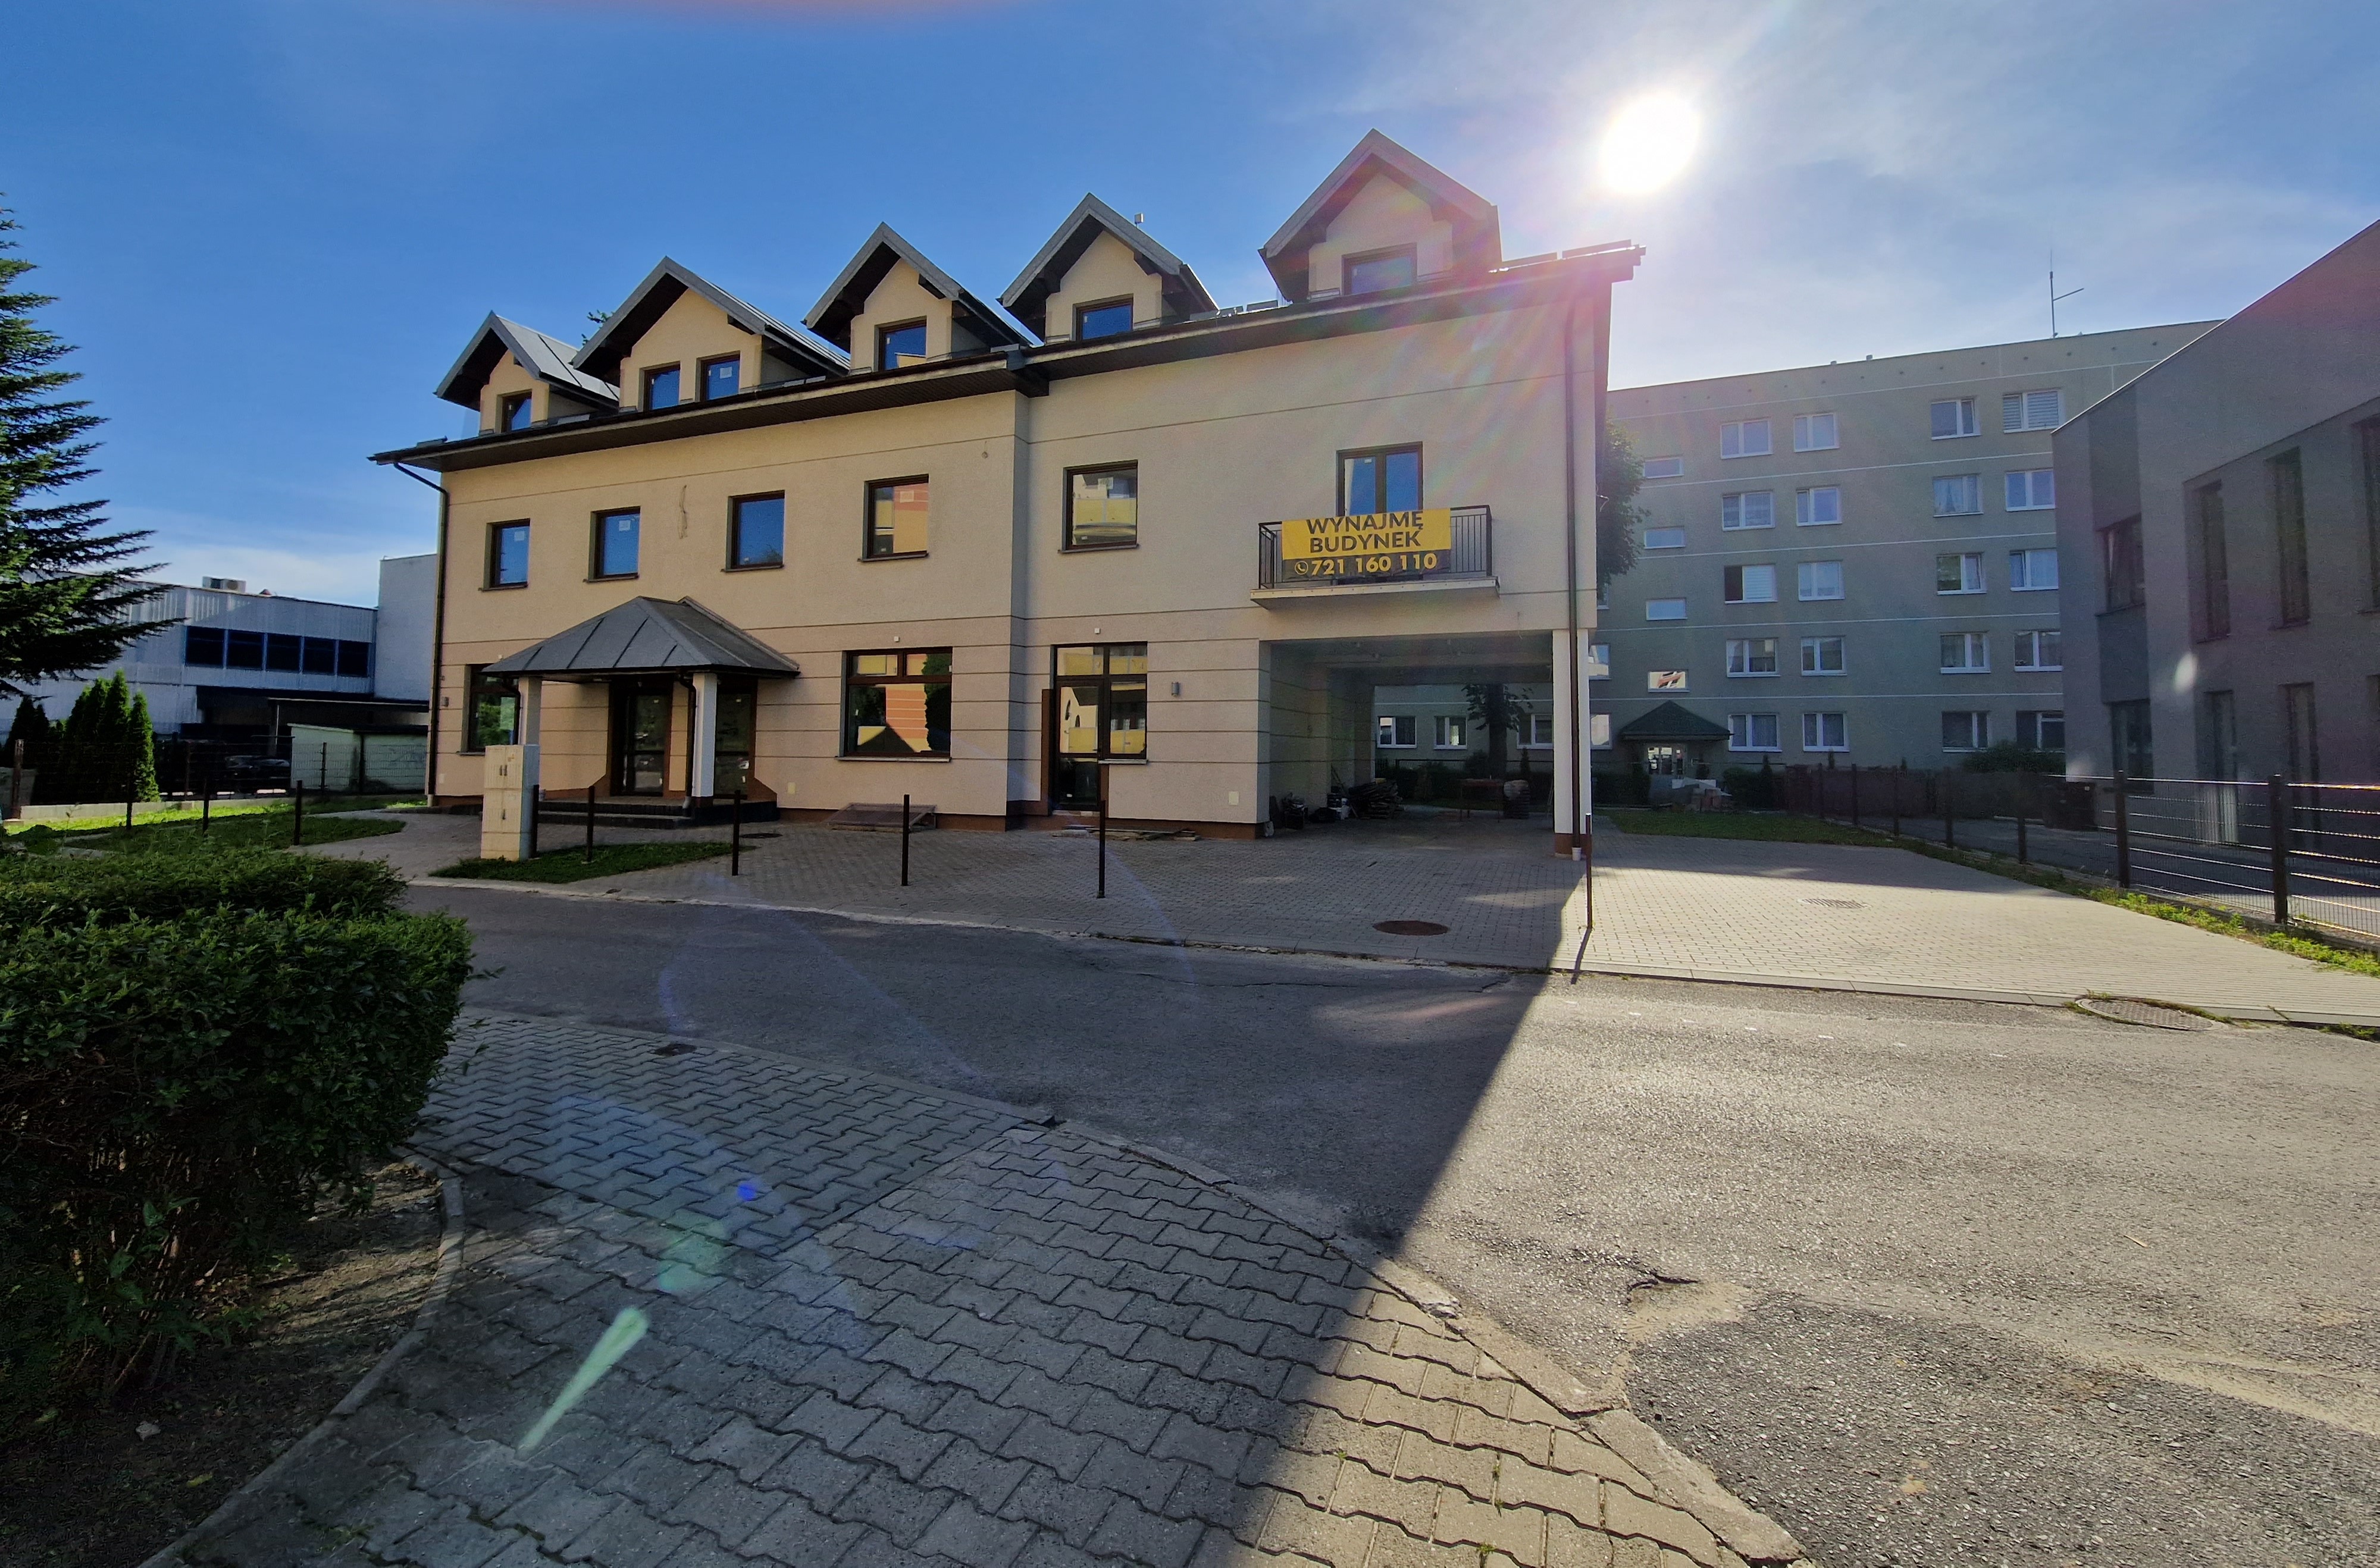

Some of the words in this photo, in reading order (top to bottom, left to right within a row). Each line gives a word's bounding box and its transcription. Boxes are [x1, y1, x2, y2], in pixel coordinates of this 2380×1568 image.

[1306, 511, 1423, 534] WYNAJMĘ
[1310, 531, 1421, 553] BUDYNEK
[1311, 559, 1345, 575] 721
[1356, 556, 1391, 573] 160
[1400, 553, 1437, 570] 110
